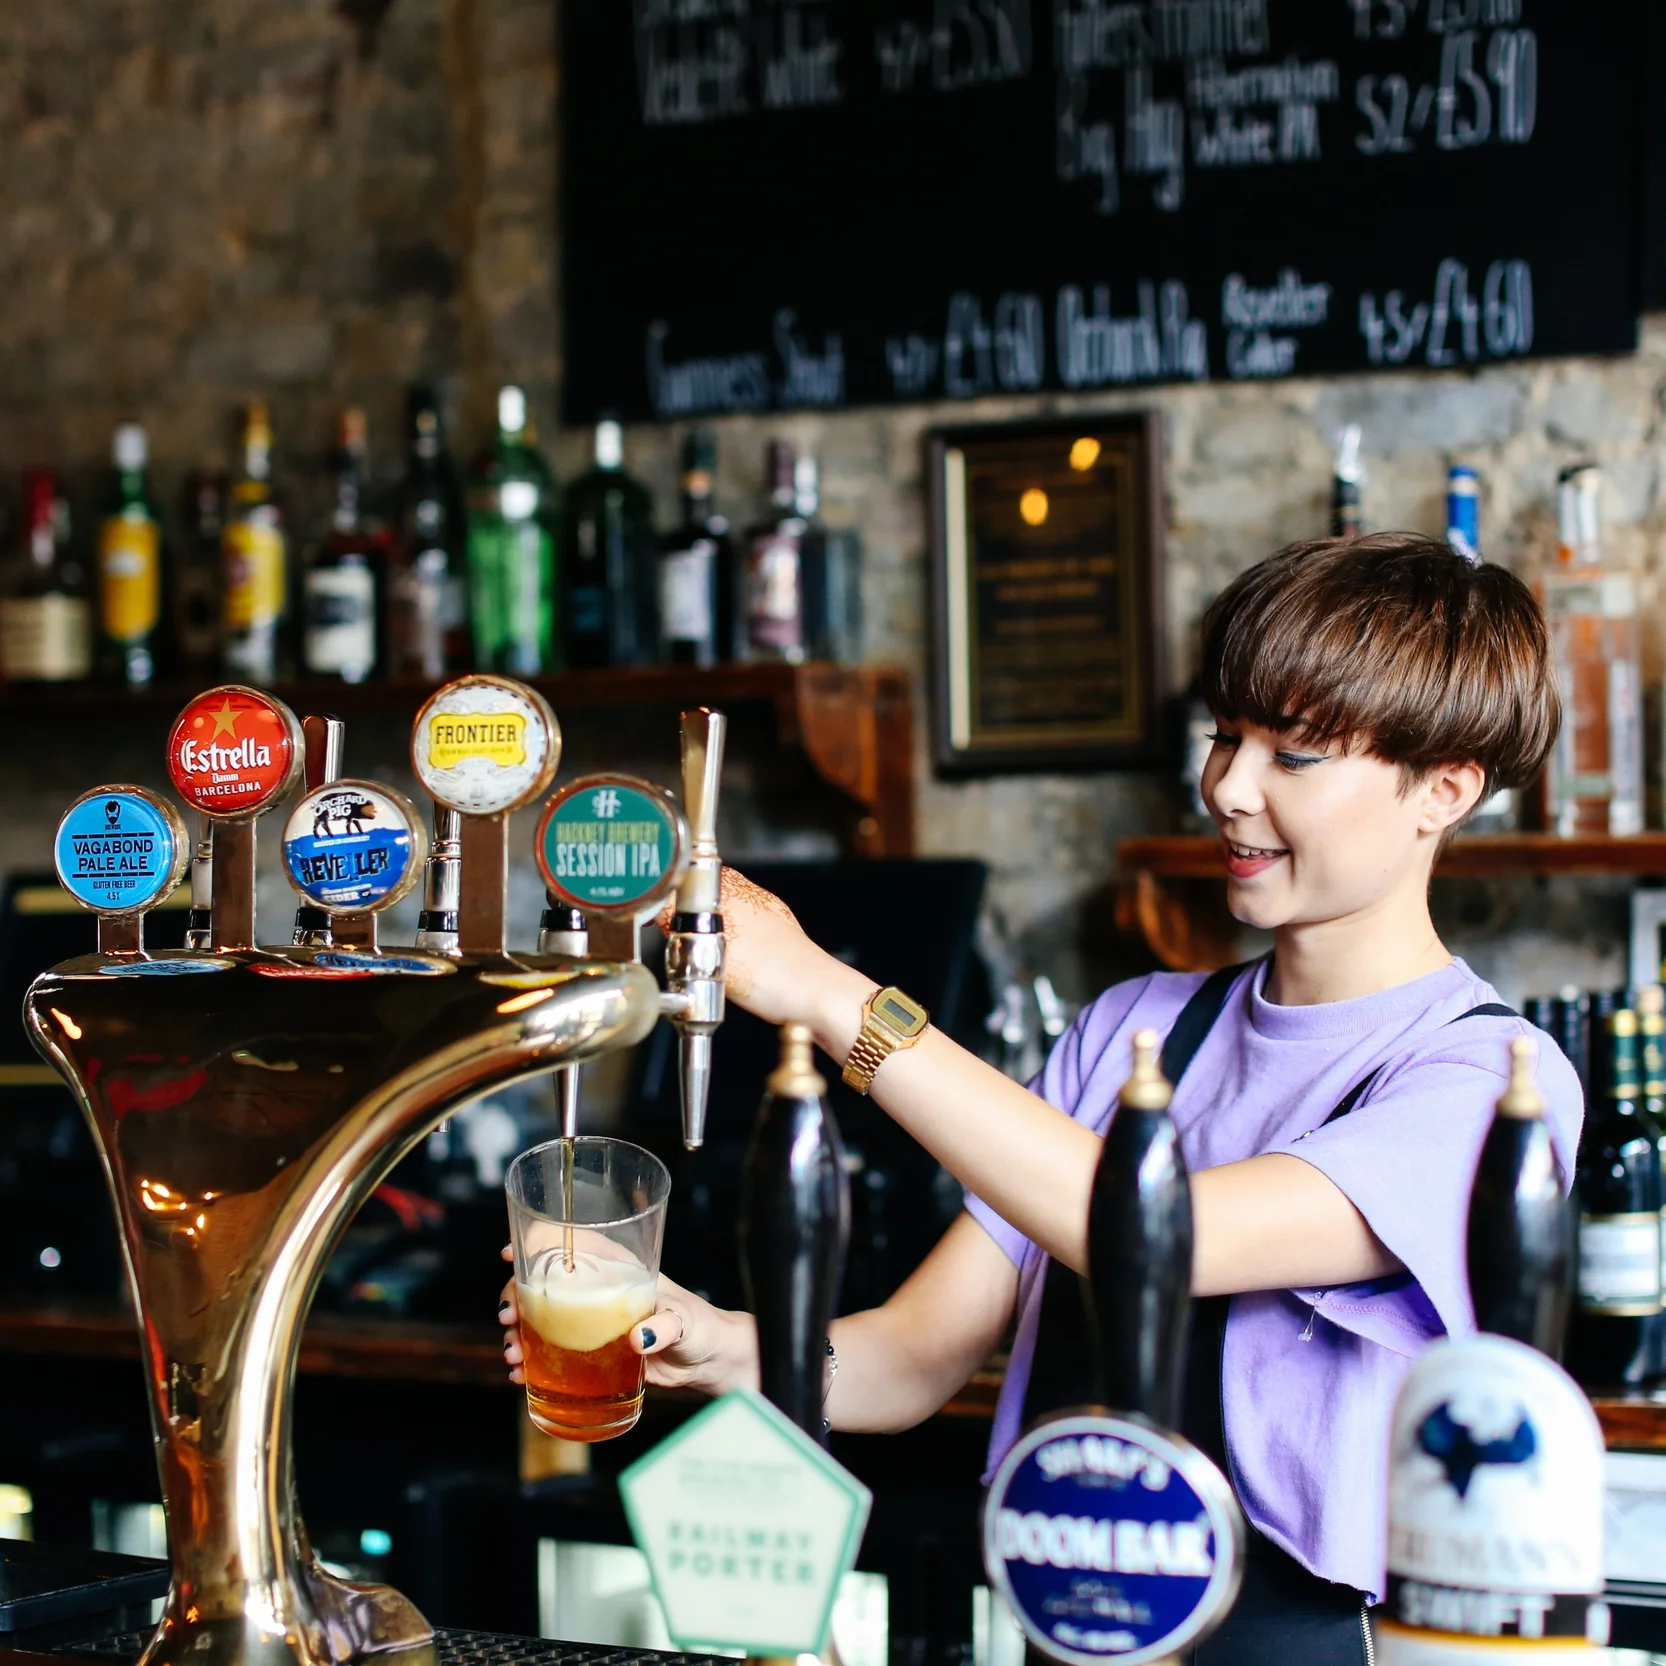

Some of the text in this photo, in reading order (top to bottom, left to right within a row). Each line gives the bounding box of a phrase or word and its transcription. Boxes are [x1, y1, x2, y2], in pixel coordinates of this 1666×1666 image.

[436, 724, 516, 744] FRONTIER
[181, 737, 271, 773] Estrella
[194, 781, 261, 796] BARCELONA
[212, 773, 239, 783] Damm
[314, 795, 368, 816] ORCHARD
[327, 804, 352, 820] PIG
[73, 840, 153, 855] VAGABOND
[79, 856, 148, 871] PALE ALE
[300, 847, 389, 885] REVELLER
[556, 842, 661, 877] SESSION IPA
[669, 1520, 813, 1549] RAILWAY
[996, 1508, 1216, 1577] DOOM BAR
[669, 1551, 813, 1583] PORTER
